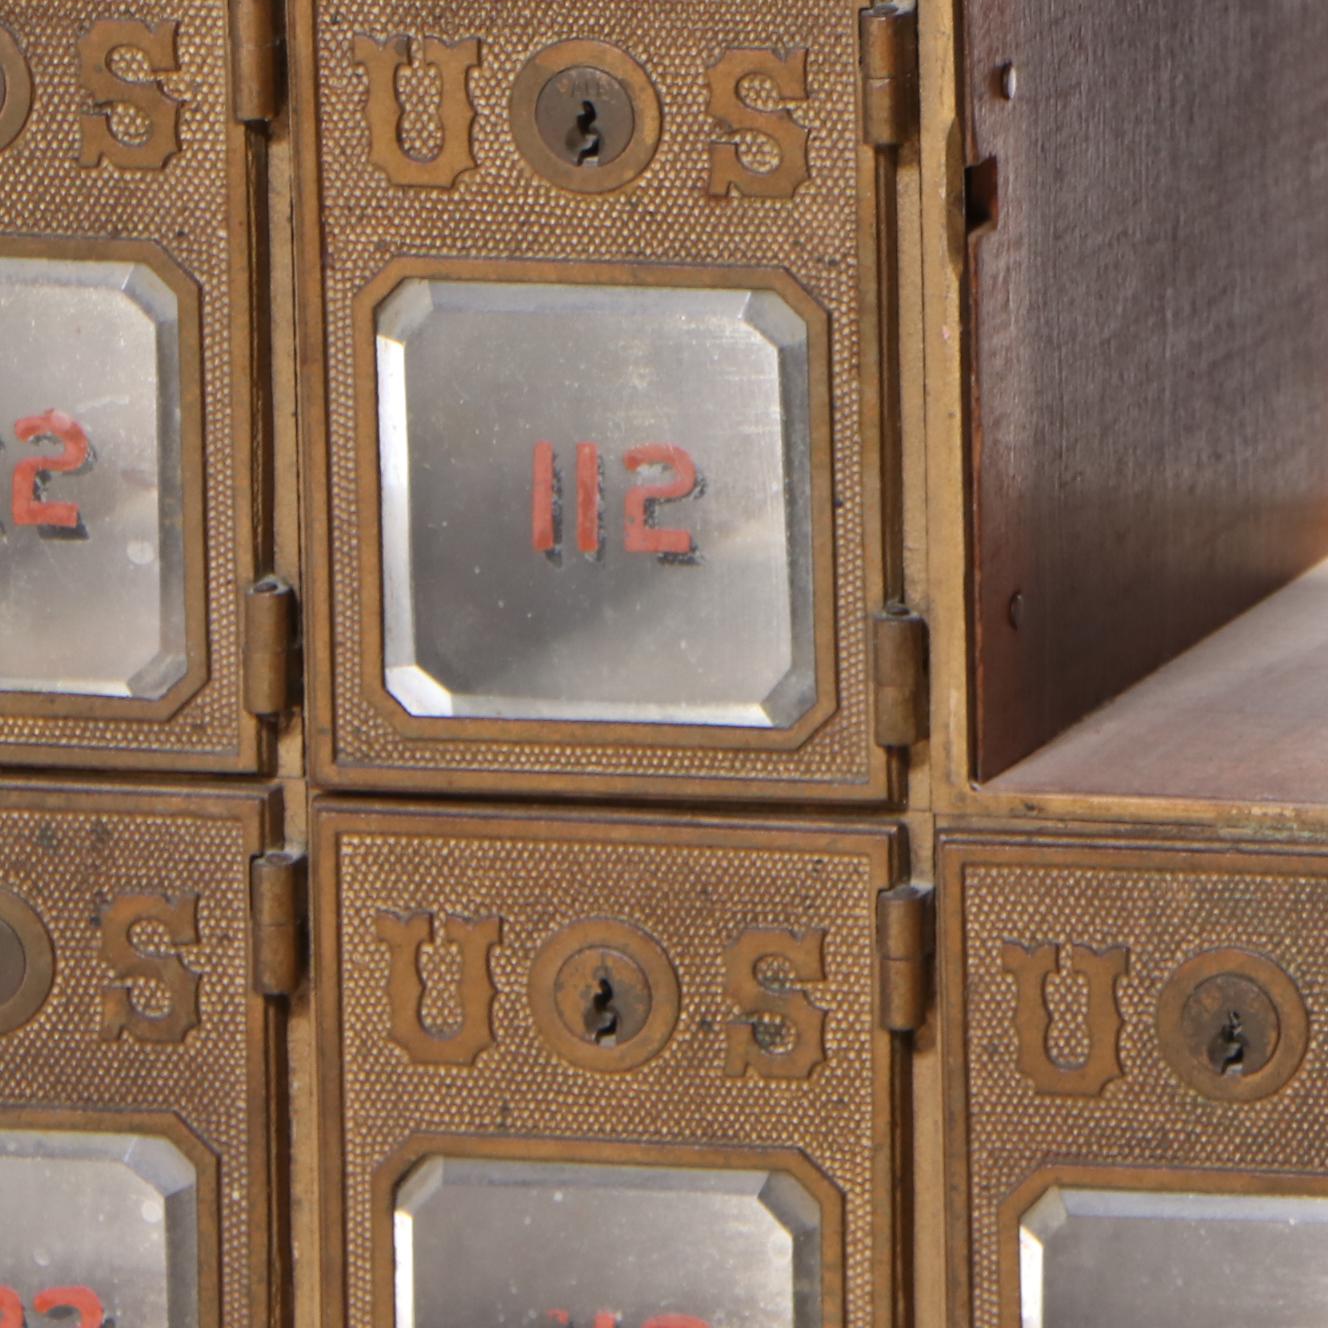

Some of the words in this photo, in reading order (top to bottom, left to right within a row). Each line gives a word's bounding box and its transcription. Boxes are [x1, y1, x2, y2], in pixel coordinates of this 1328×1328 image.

[75, 17, 184, 170] S
[353, 33, 483, 190] U
[705, 43, 813, 199] S
[0, 408, 98, 541] 2
[531, 440, 707, 568] 112
[97, 892, 202, 1045] S
[374, 908, 504, 1068] U
[722, 924, 830, 1080] S
[1001, 939, 1131, 1098] U
